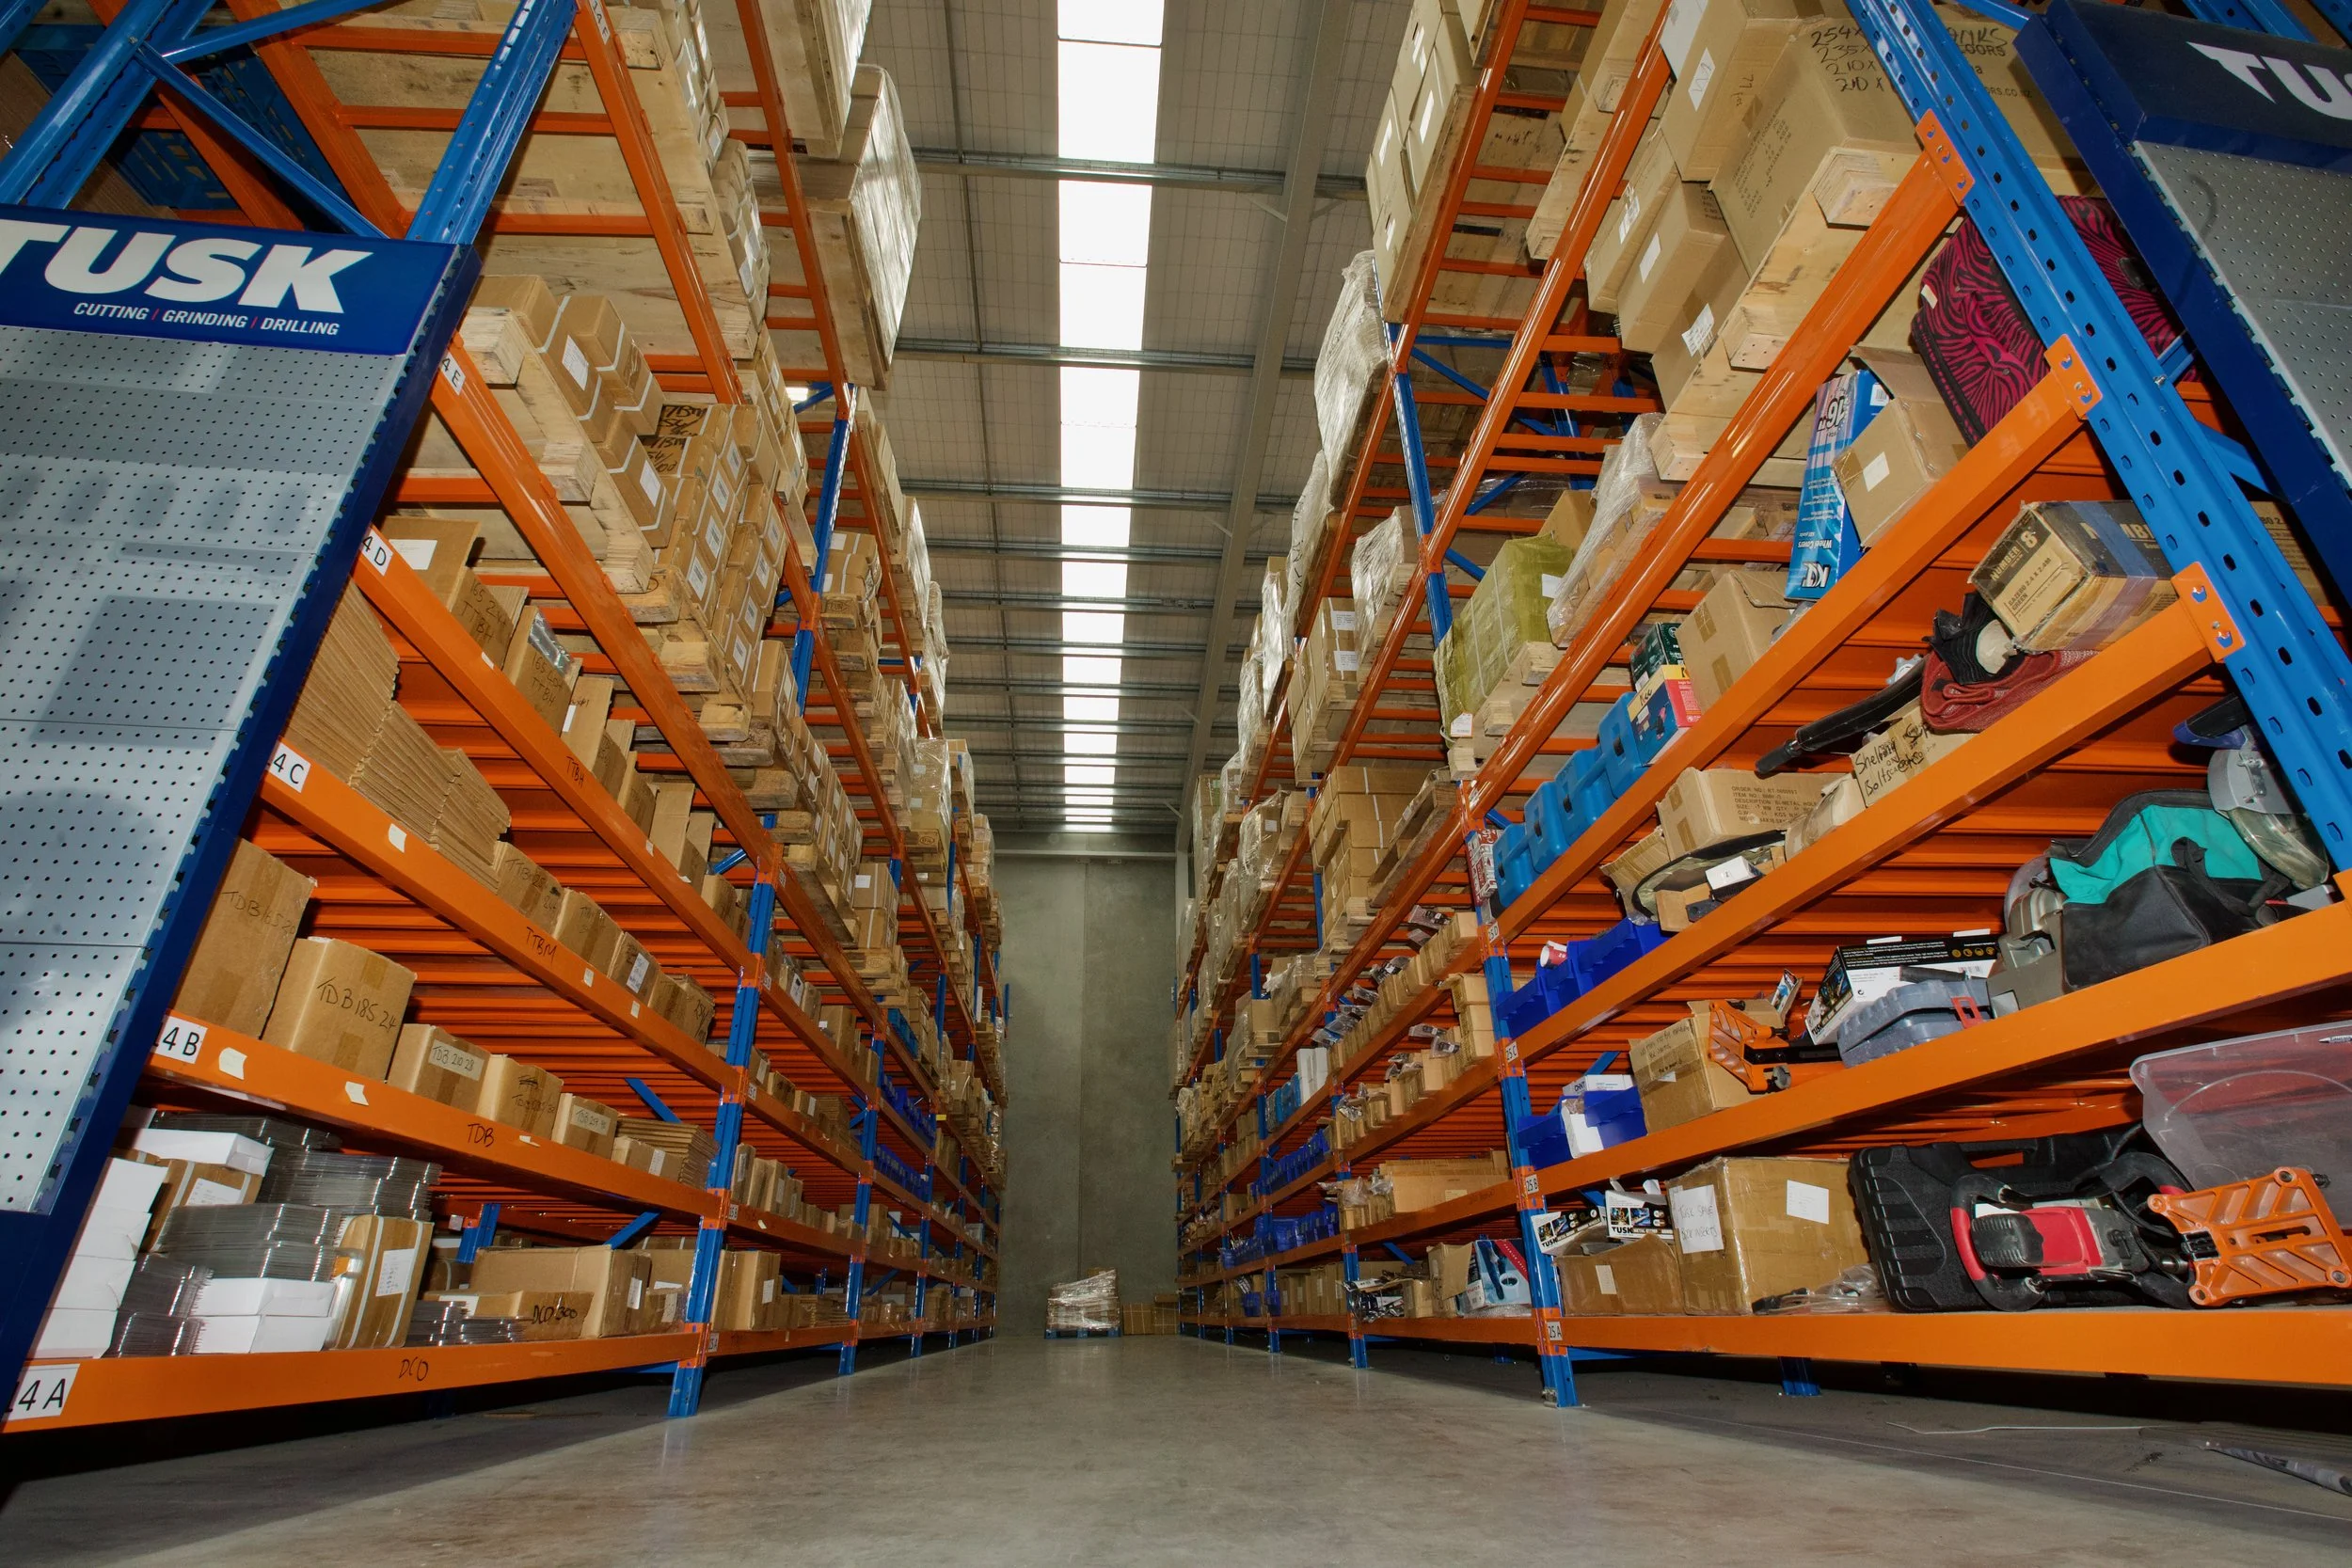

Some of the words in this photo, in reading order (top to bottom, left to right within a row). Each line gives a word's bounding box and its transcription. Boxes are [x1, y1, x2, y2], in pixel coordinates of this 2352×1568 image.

[2185, 40, 2352, 120] TU
[73, 301, 150, 321] CUTTING
[162, 309, 248, 329] GRINDING
[260, 316, 340, 336] DRILLING
[2021, 530, 2039, 549] 8
[373, 546, 387, 566] D
[1990, 546, 2021, 581] NUMBER
[2011, 592, 2028, 611] GREEN
[290, 763, 305, 784] C
[183, 1031, 200, 1056] B
[467, 1123, 495, 1148] TDB
[1612, 1226, 1633, 1234] TUSK
[1542, 1236, 1559, 1248] TUSK
[42, 1378, 66, 1410] A
